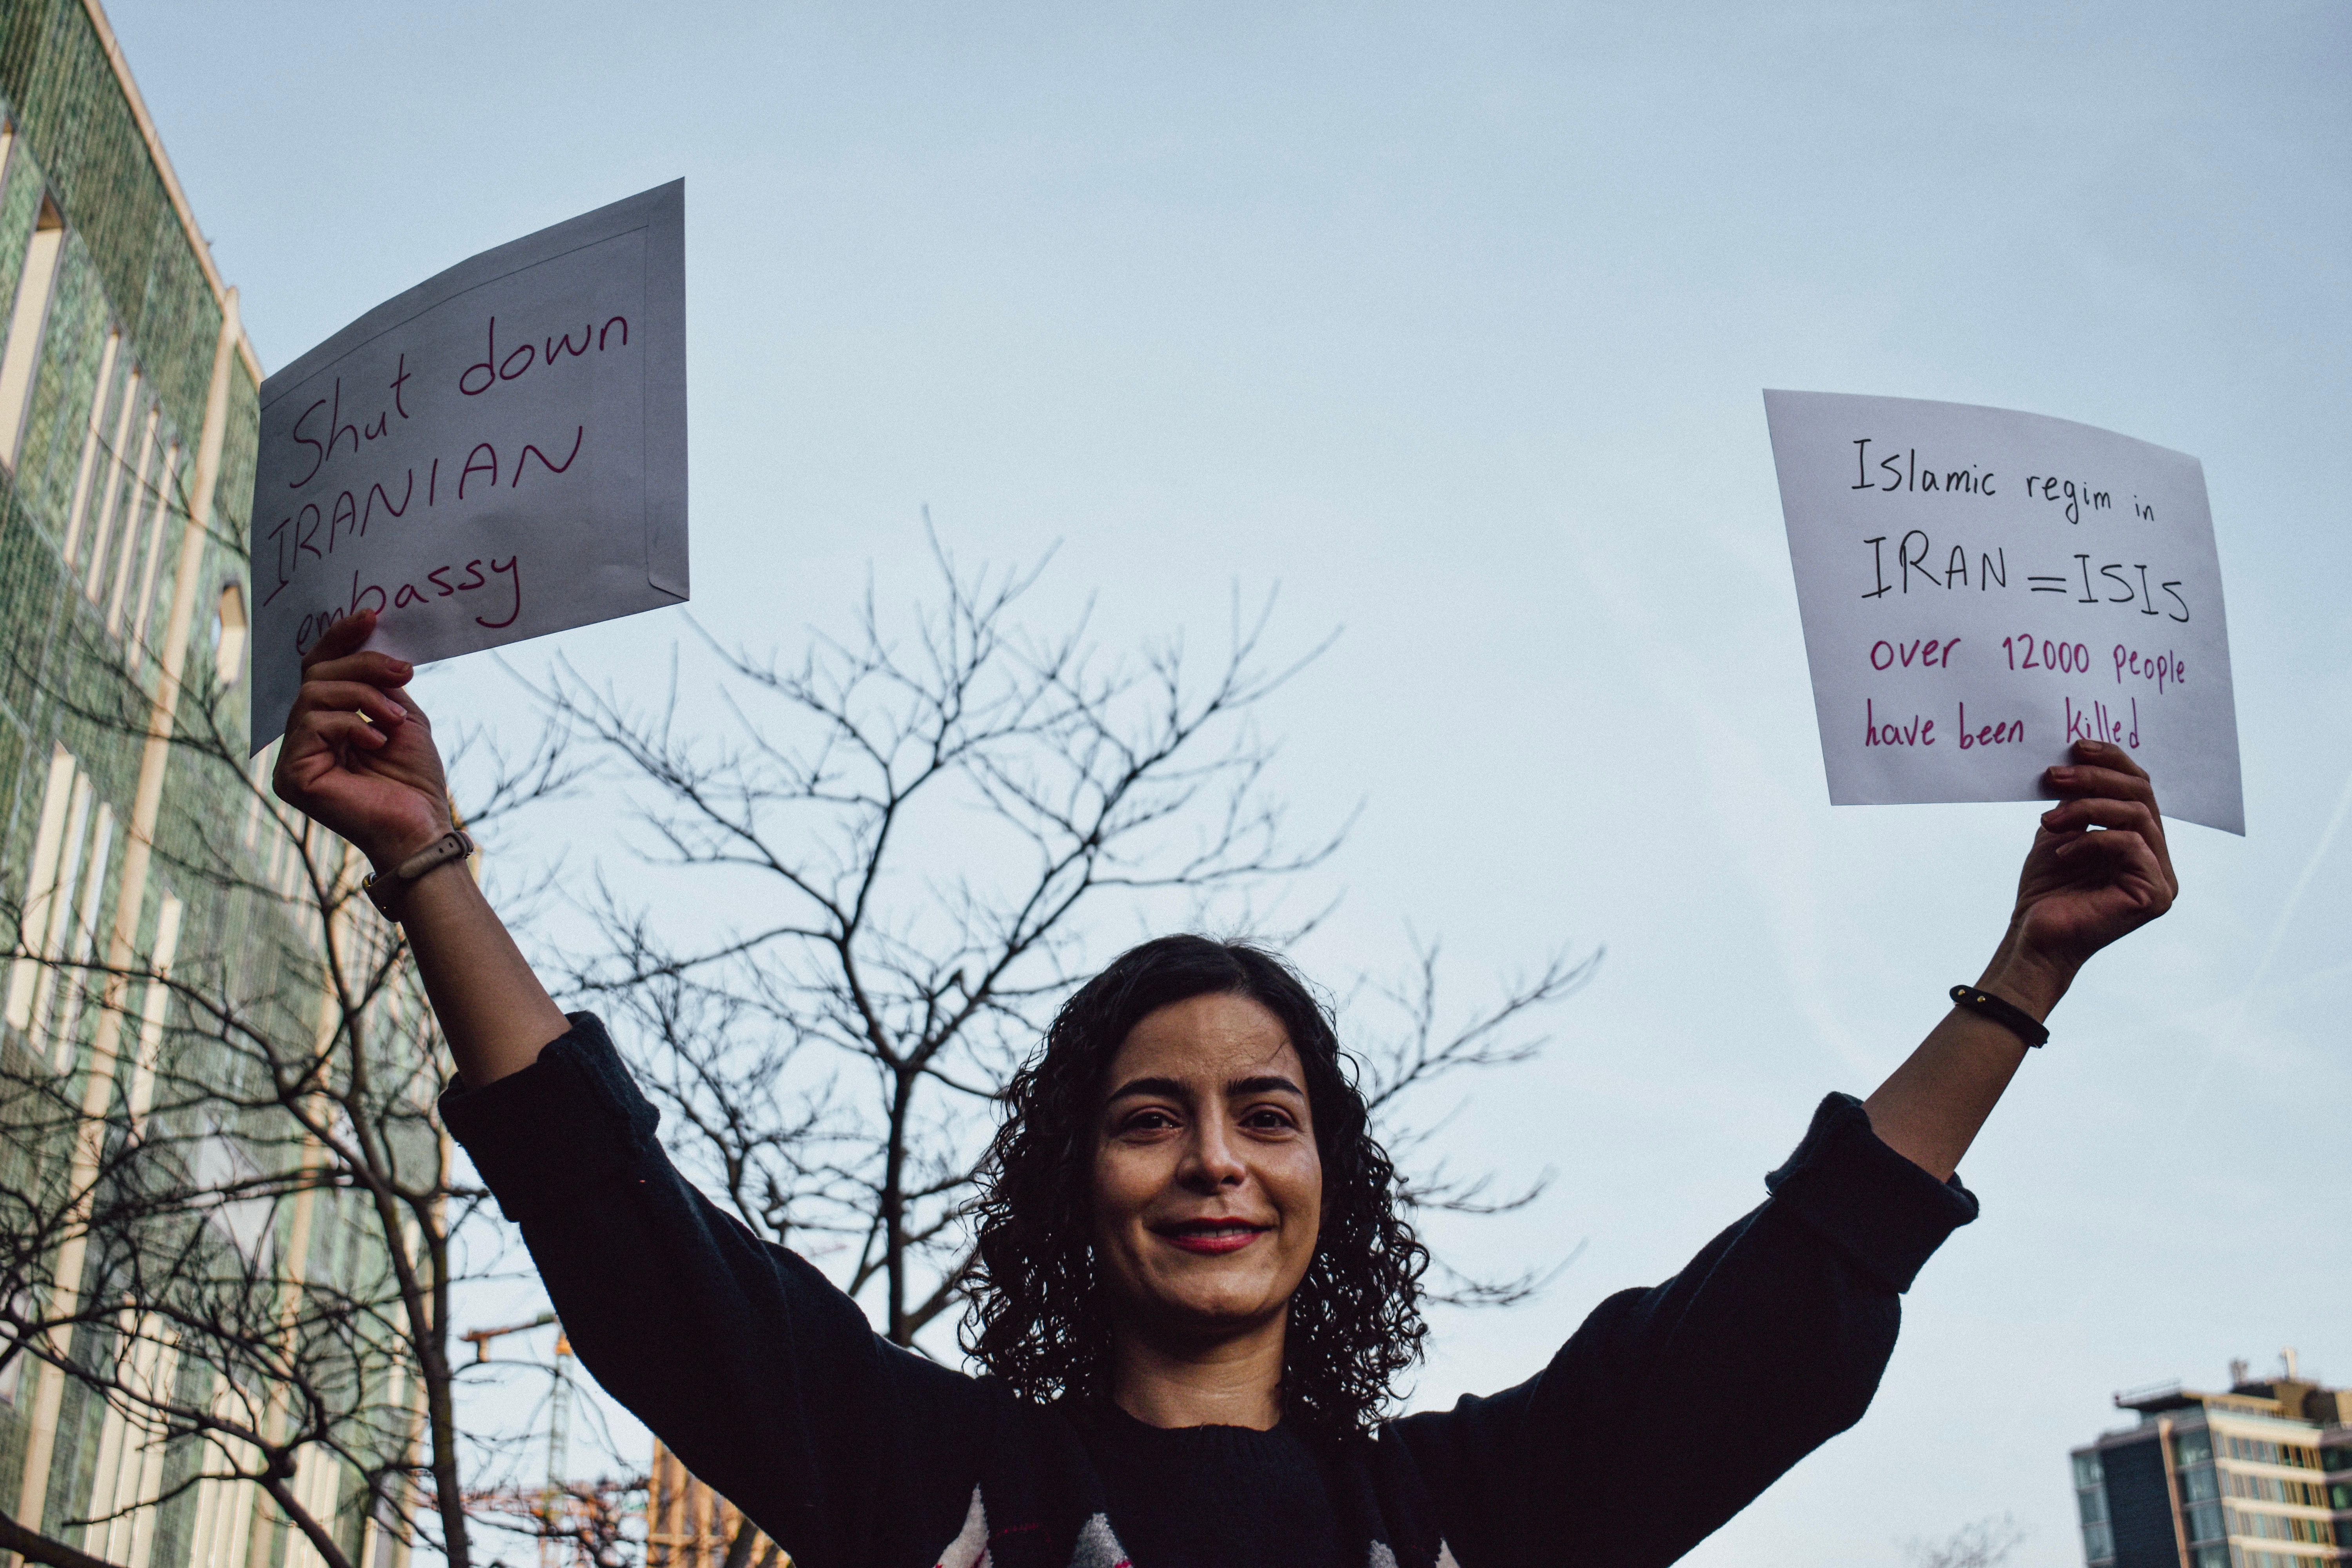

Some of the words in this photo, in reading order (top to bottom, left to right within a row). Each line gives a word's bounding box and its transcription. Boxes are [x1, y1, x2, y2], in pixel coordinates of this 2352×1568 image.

[289, 353, 412, 490] Shut
[459, 316, 628, 396] down
[263, 425, 584, 607] IRANIAN
[1851, 438, 1996, 496] Islamic
[2026, 475, 2111, 525] regim
[2134, 494, 2155, 522] in
[295, 555, 521, 657] embassy
[1861, 529, 2007, 599] IRAN
[1869, 637, 1962, 671] over
[2002, 633, 2090, 673] 12000
[2112, 644, 2186, 695] people
[1865, 698, 1936, 747] have
[1958, 701, 2025, 750] been
[2065, 696, 2140, 749] killed
